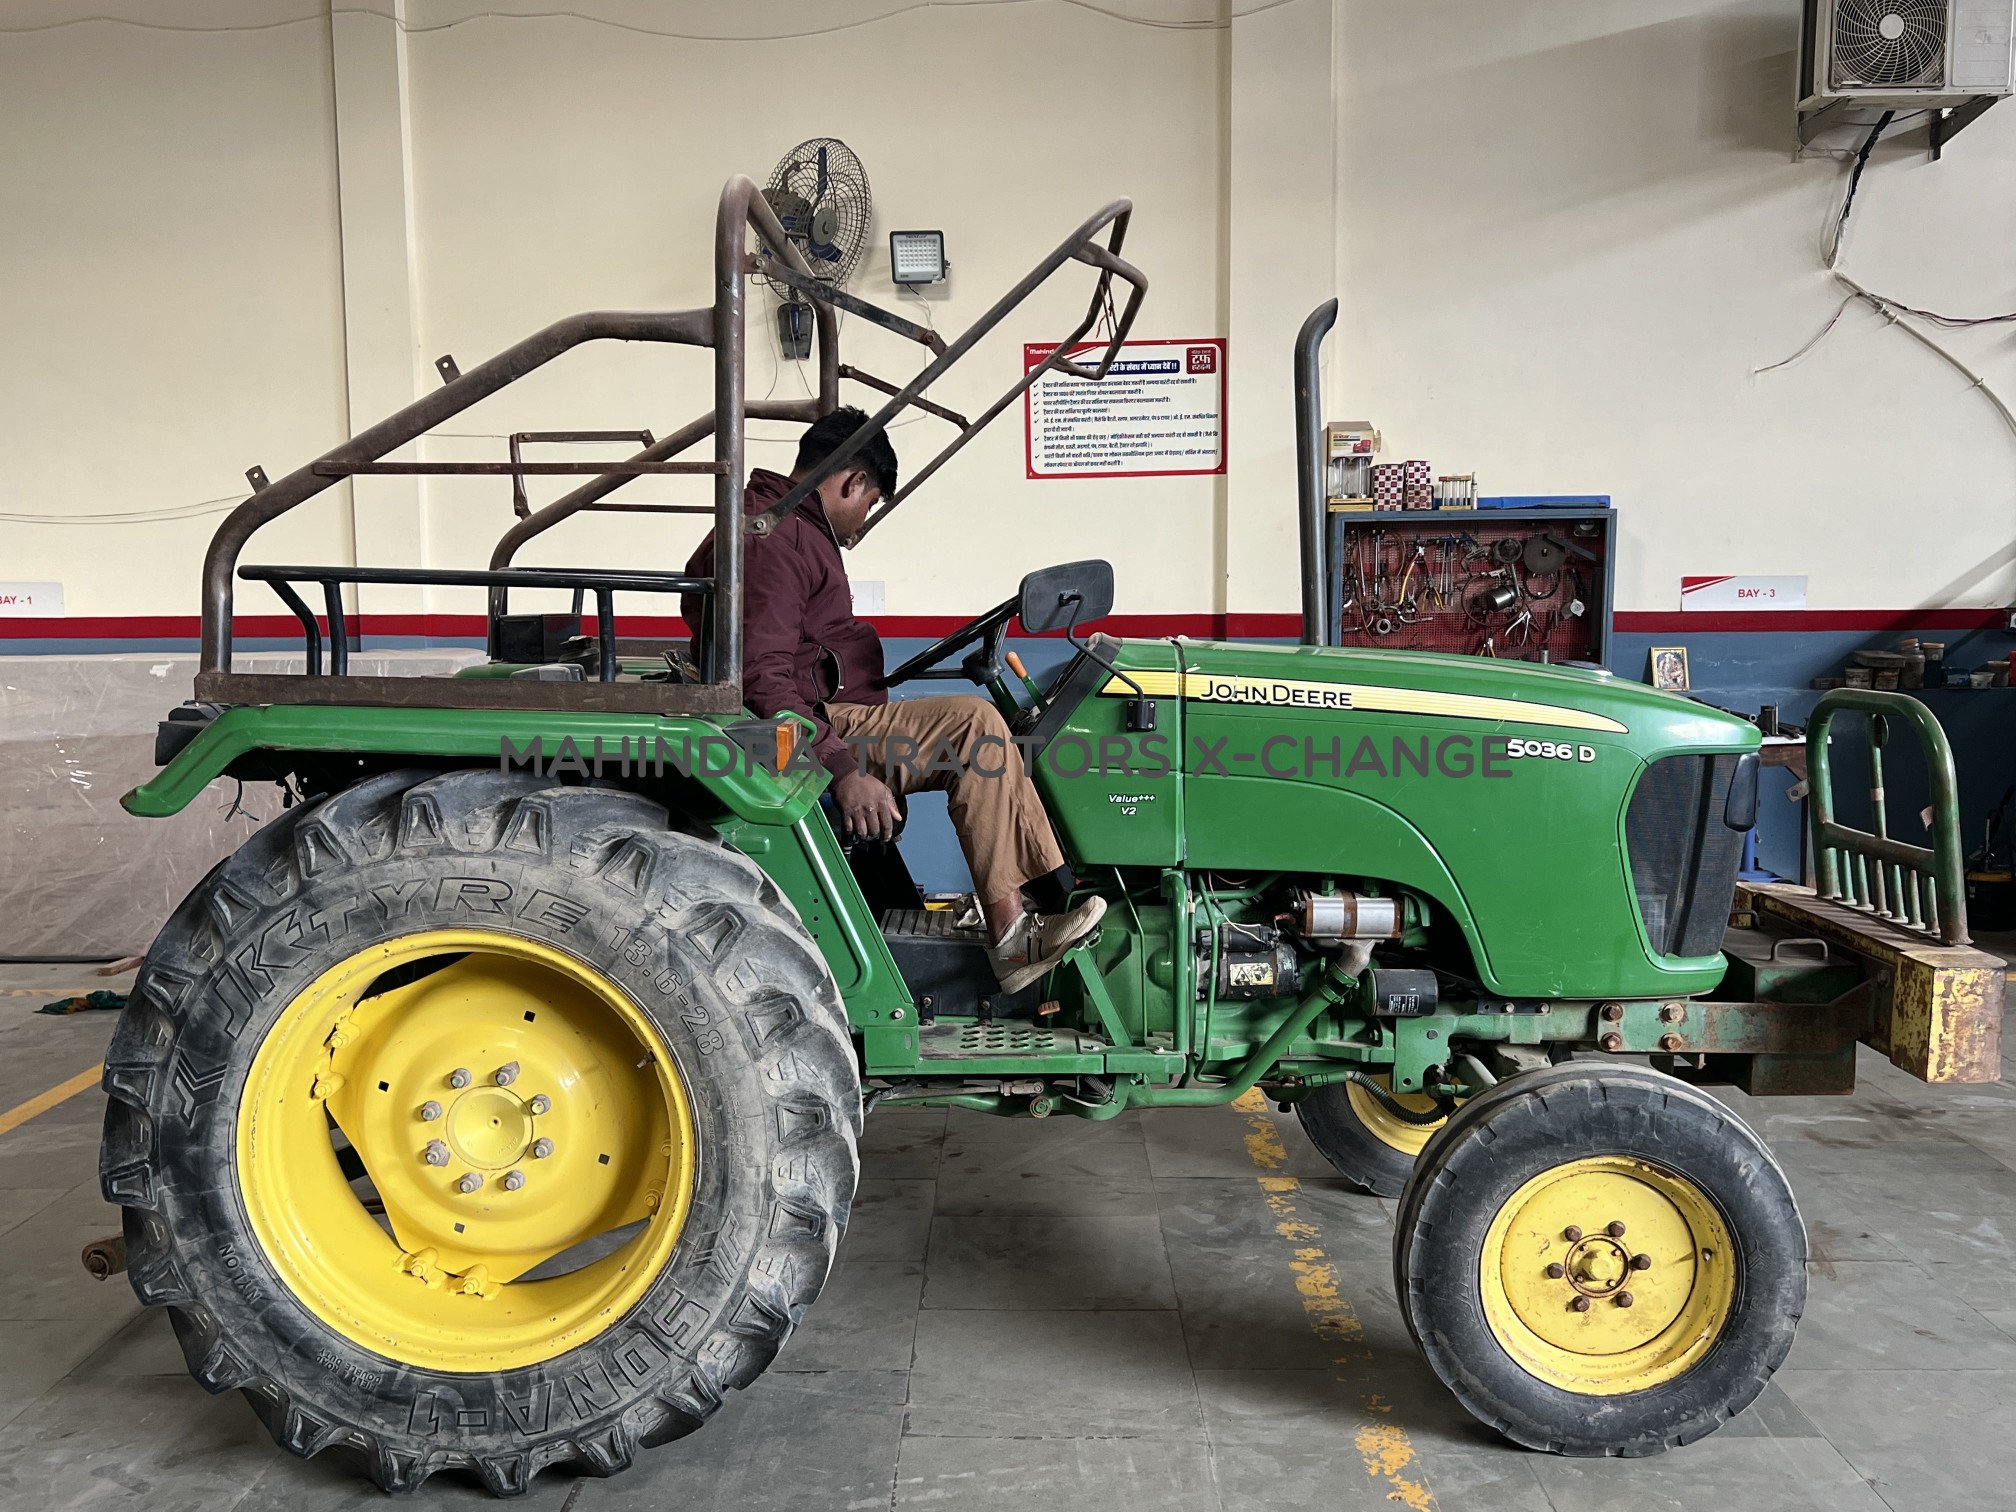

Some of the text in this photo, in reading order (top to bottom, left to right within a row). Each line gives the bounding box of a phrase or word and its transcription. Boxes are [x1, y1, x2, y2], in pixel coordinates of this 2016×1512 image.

[27, 595, 32, 605] 1
[1738, 588, 1760, 598] BAY
[1769, 588, 1776, 598] 3
[1200, 679, 1354, 708] JOHN DEERE
[1506, 738, 1597, 763] 5036 D
[1121, 806, 1137, 815] V2
[608, 925, 725, 1056] 13.6-28
[218, 1242, 263, 1305] NYLON
[314, 1355, 340, 1375] ROAD
[318, 1348, 382, 1384] DOUBLE DUTY
[349, 1375, 377, 1391] FIELD
